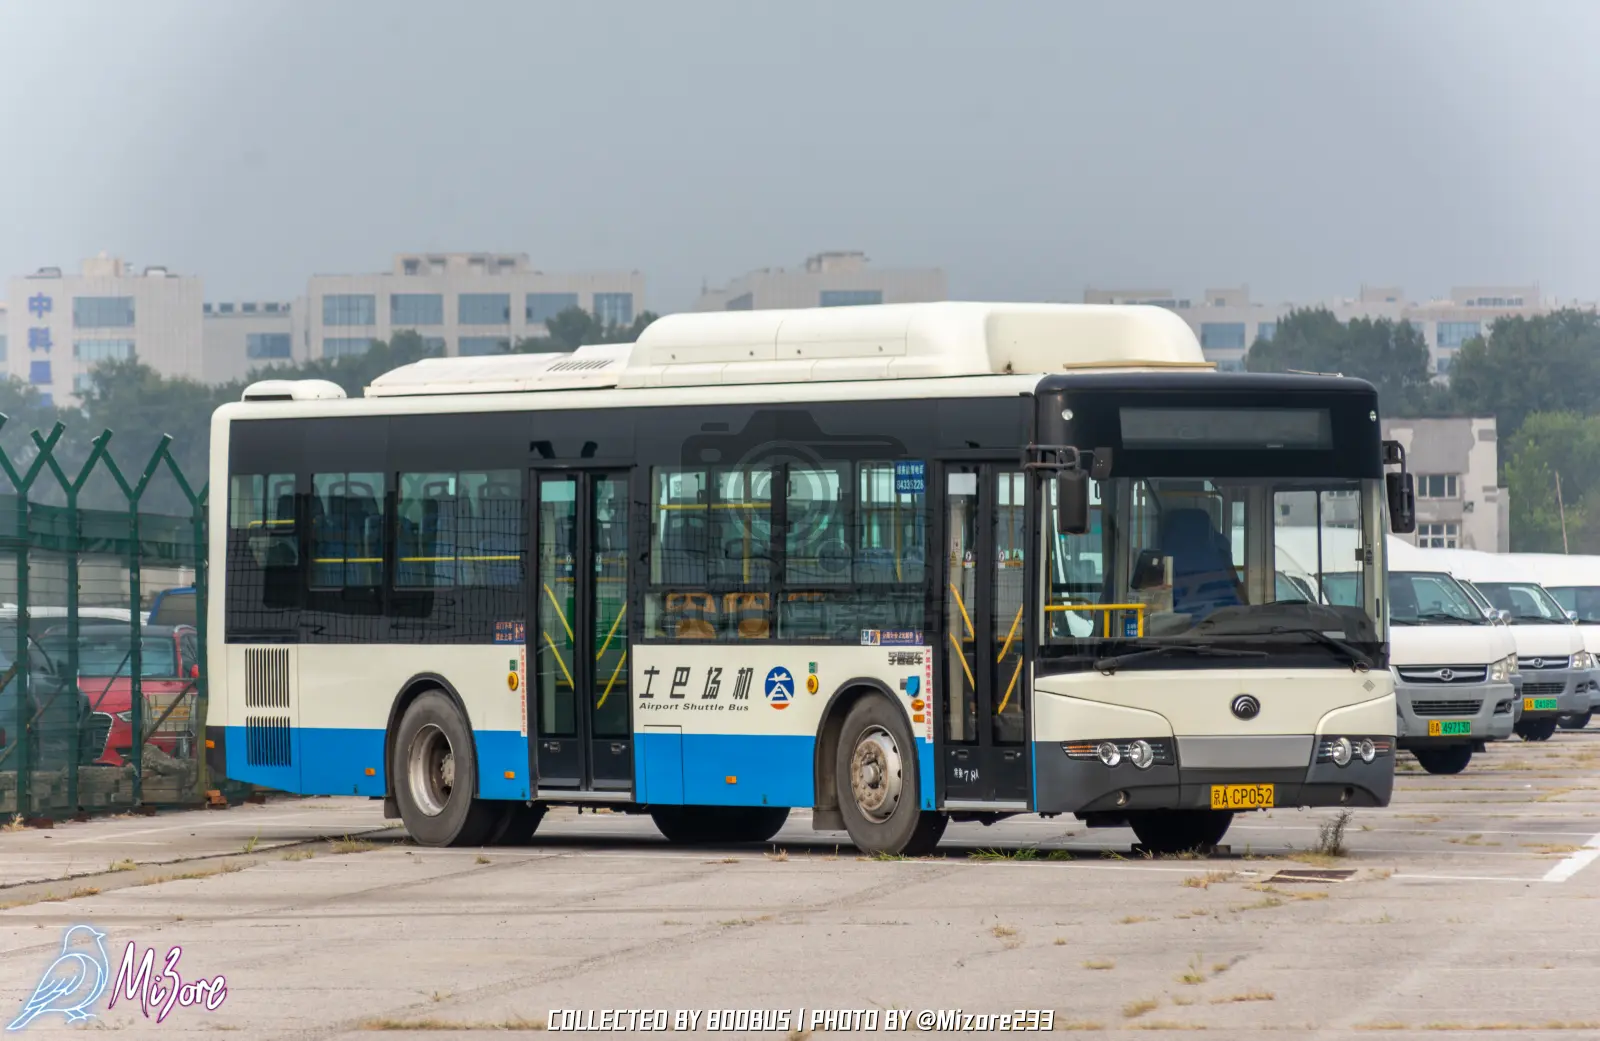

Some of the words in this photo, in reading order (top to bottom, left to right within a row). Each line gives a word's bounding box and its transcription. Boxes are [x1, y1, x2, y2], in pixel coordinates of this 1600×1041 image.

[638, 702, 679, 711] Airport
[682, 702, 725, 711] Shuttle
[728, 703, 749, 711] Bus
